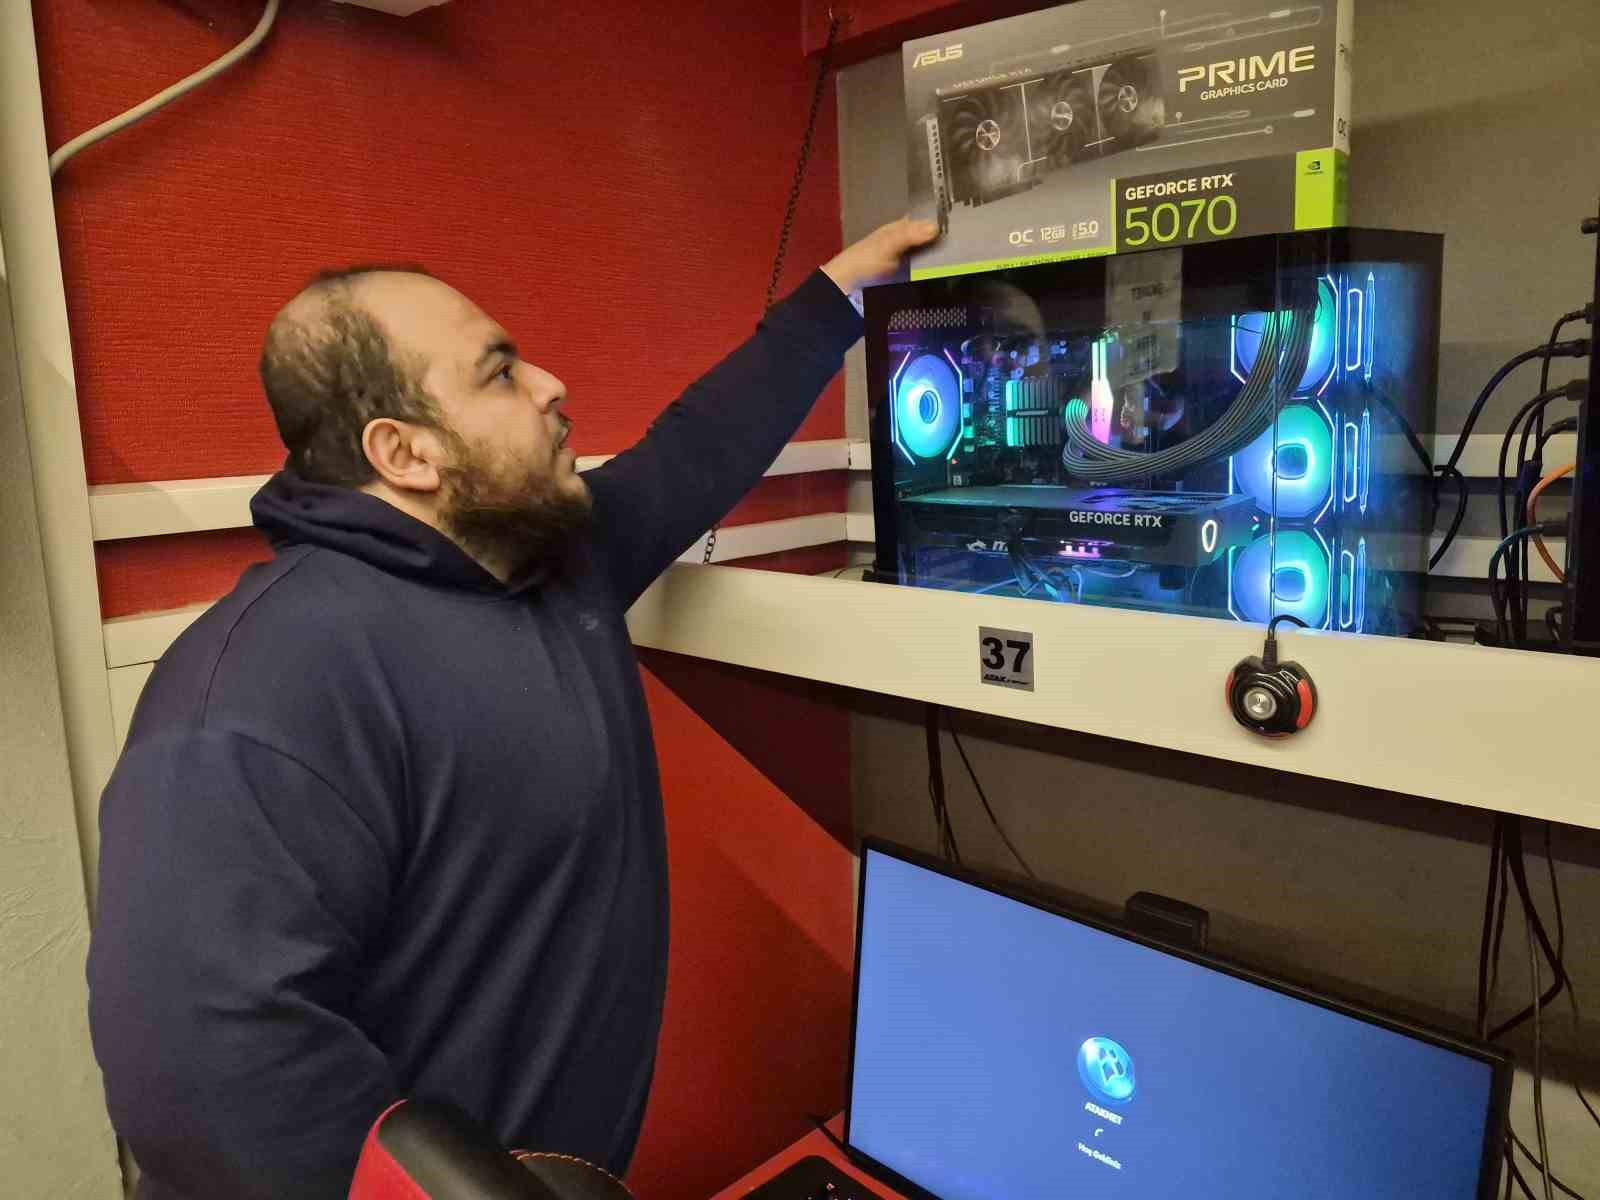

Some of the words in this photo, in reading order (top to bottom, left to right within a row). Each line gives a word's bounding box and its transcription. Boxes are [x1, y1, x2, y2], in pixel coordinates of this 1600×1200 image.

[912, 43, 963, 69] ASUS
[1177, 45, 1315, 93] PRIME
[1200, 83, 1255, 101] GRAPHICS
[1256, 77, 1289, 92] CARD
[1125, 178, 1198, 201] GEFORCE
[1200, 173, 1234, 191] RTX
[1125, 195, 1237, 246] 5070
[1008, 229, 1034, 245] OC
[1069, 510, 1131, 526] GEFORCE
[1134, 514, 1162, 528] RTX
[982, 636, 1030, 673] 37
